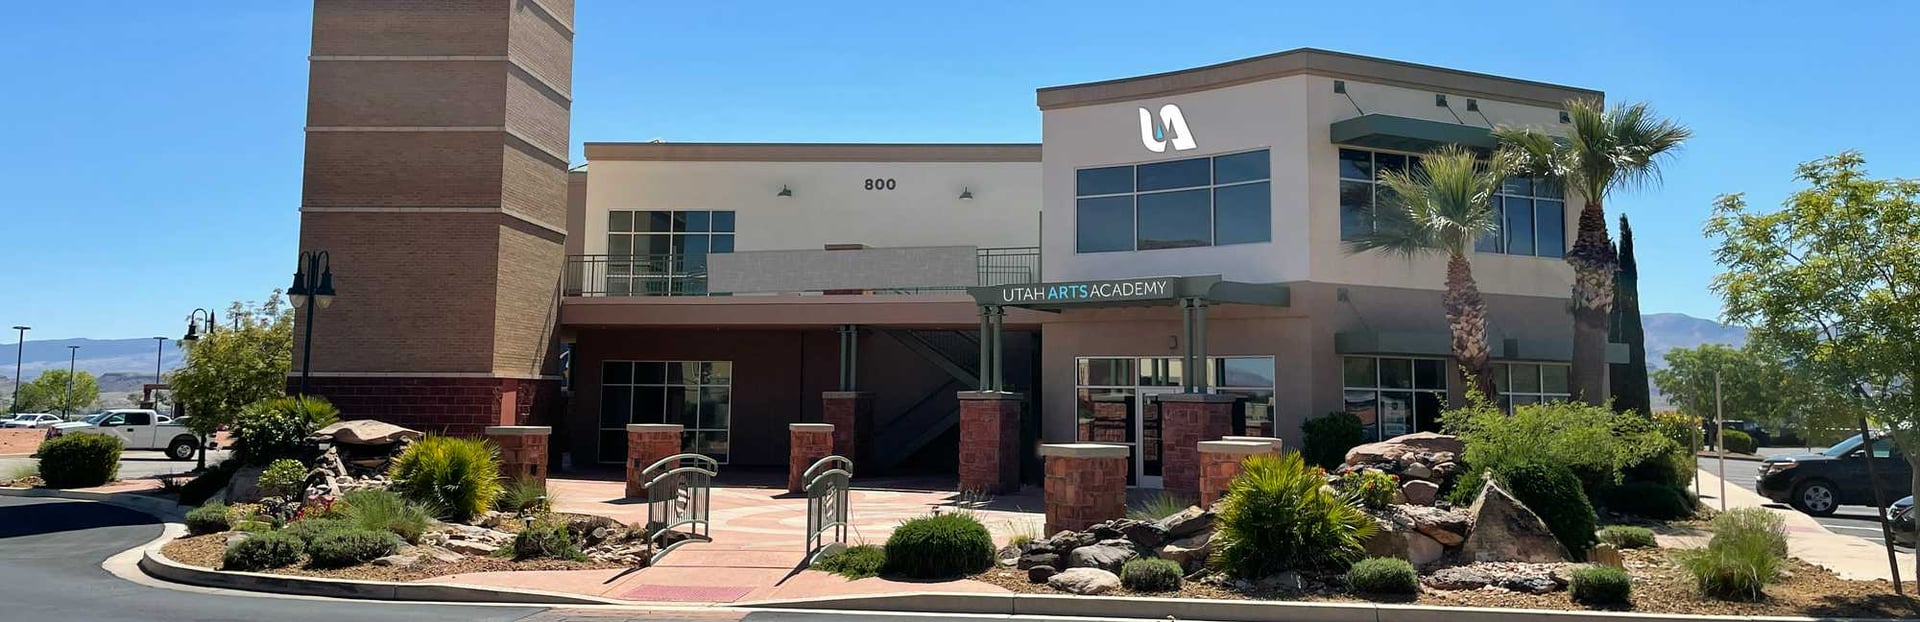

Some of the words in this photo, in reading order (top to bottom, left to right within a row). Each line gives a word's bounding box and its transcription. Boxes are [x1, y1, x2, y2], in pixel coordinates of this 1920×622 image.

[864, 178, 896, 191] 800
[1002, 287, 1045, 302] UTAH
[1047, 284, 1088, 300] ARTS
[1089, 280, 1167, 298] ACADEMY
